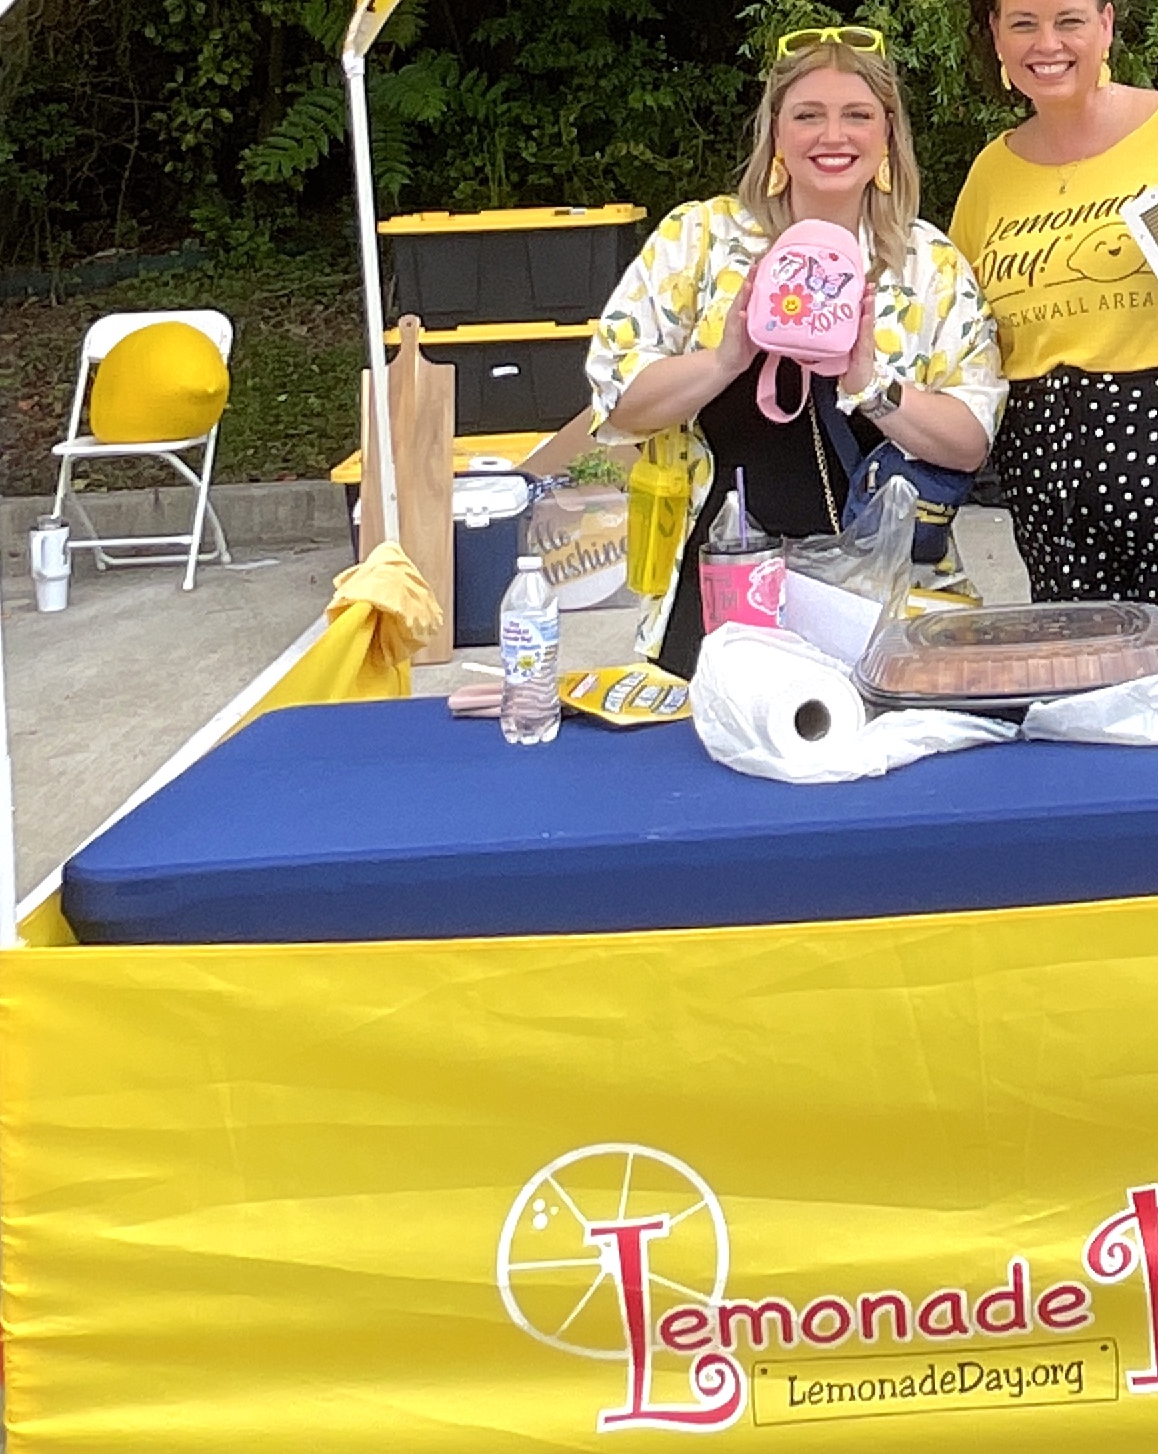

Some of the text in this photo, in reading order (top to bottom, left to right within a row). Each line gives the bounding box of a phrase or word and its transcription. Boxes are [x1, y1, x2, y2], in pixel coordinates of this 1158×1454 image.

[983, 184, 1148, 249] Lemonad
[981, 235, 1061, 289] Day!
[806, 302, 854, 336] XOXO
[1002, 291, 1155, 329] CKWALL AREA
[542, 534, 628, 586] nshin
[587, 1217, 1090, 1429] Lemonade
[787, 1359, 1084, 1408] LemonadeDay.org
